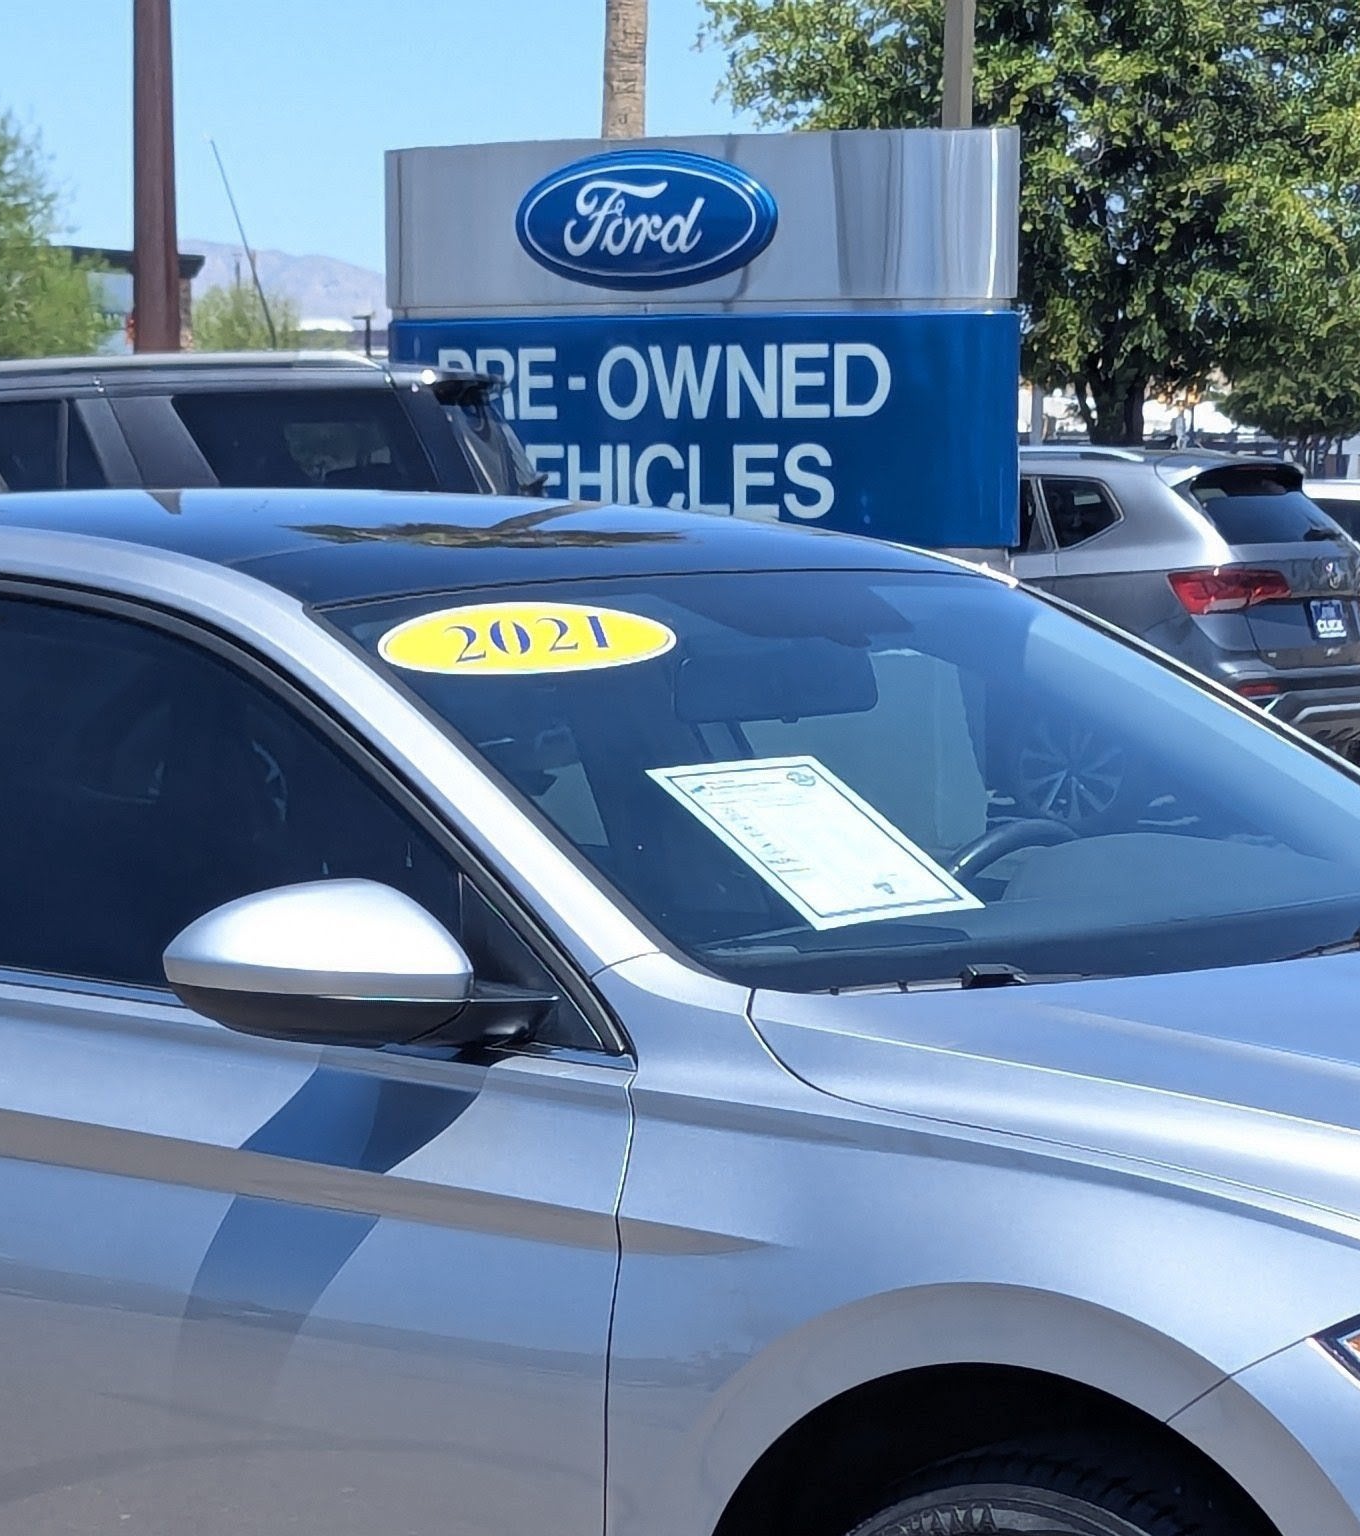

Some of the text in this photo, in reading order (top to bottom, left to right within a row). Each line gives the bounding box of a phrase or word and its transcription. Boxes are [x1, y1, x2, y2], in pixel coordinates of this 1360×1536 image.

[563, 178, 705, 257] Ford
[526, 442, 836, 520] EHICLES
[444, 613, 611, 665] 2021
